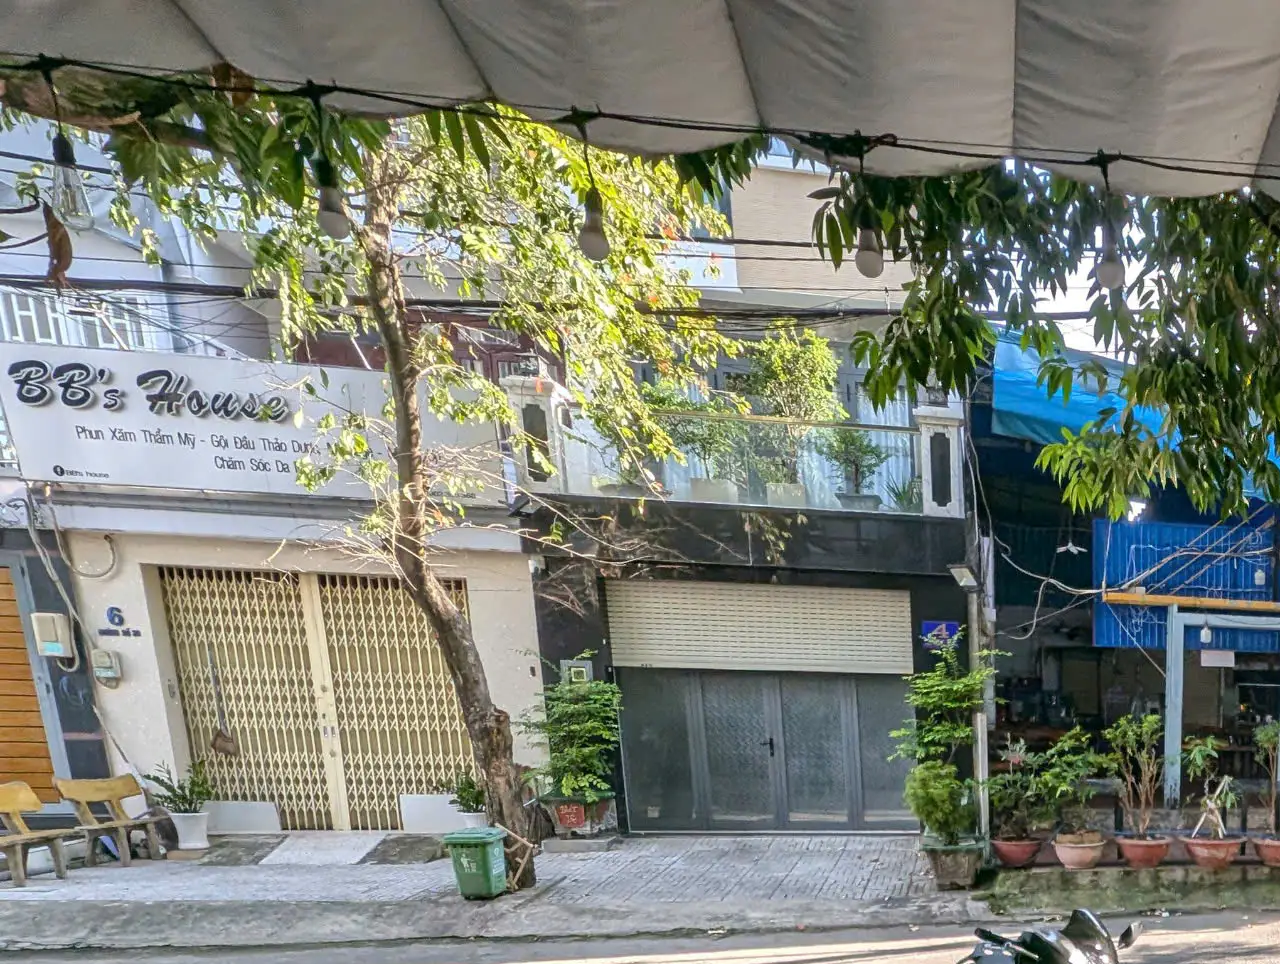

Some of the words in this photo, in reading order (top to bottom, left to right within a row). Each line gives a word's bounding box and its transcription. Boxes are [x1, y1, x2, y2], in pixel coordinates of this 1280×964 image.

[7, 359, 123, 411] BB's
[136, 368, 289, 421] House
[75, 425, 105, 440] Phun
[108, 426, 137, 442] Xăm
[140, 427, 174, 445] Thẩm
[177, 431, 196, 449] Mỹ
[211, 434, 229, 450] Gội
[259, 437, 288, 452] Thảo
[214, 455, 246, 471] Chăm
[250, 458, 271, 472] Sóc
[275, 460, 290, 473] Da
[106, 606, 125, 627] 6
[931, 623, 950, 639] 4
